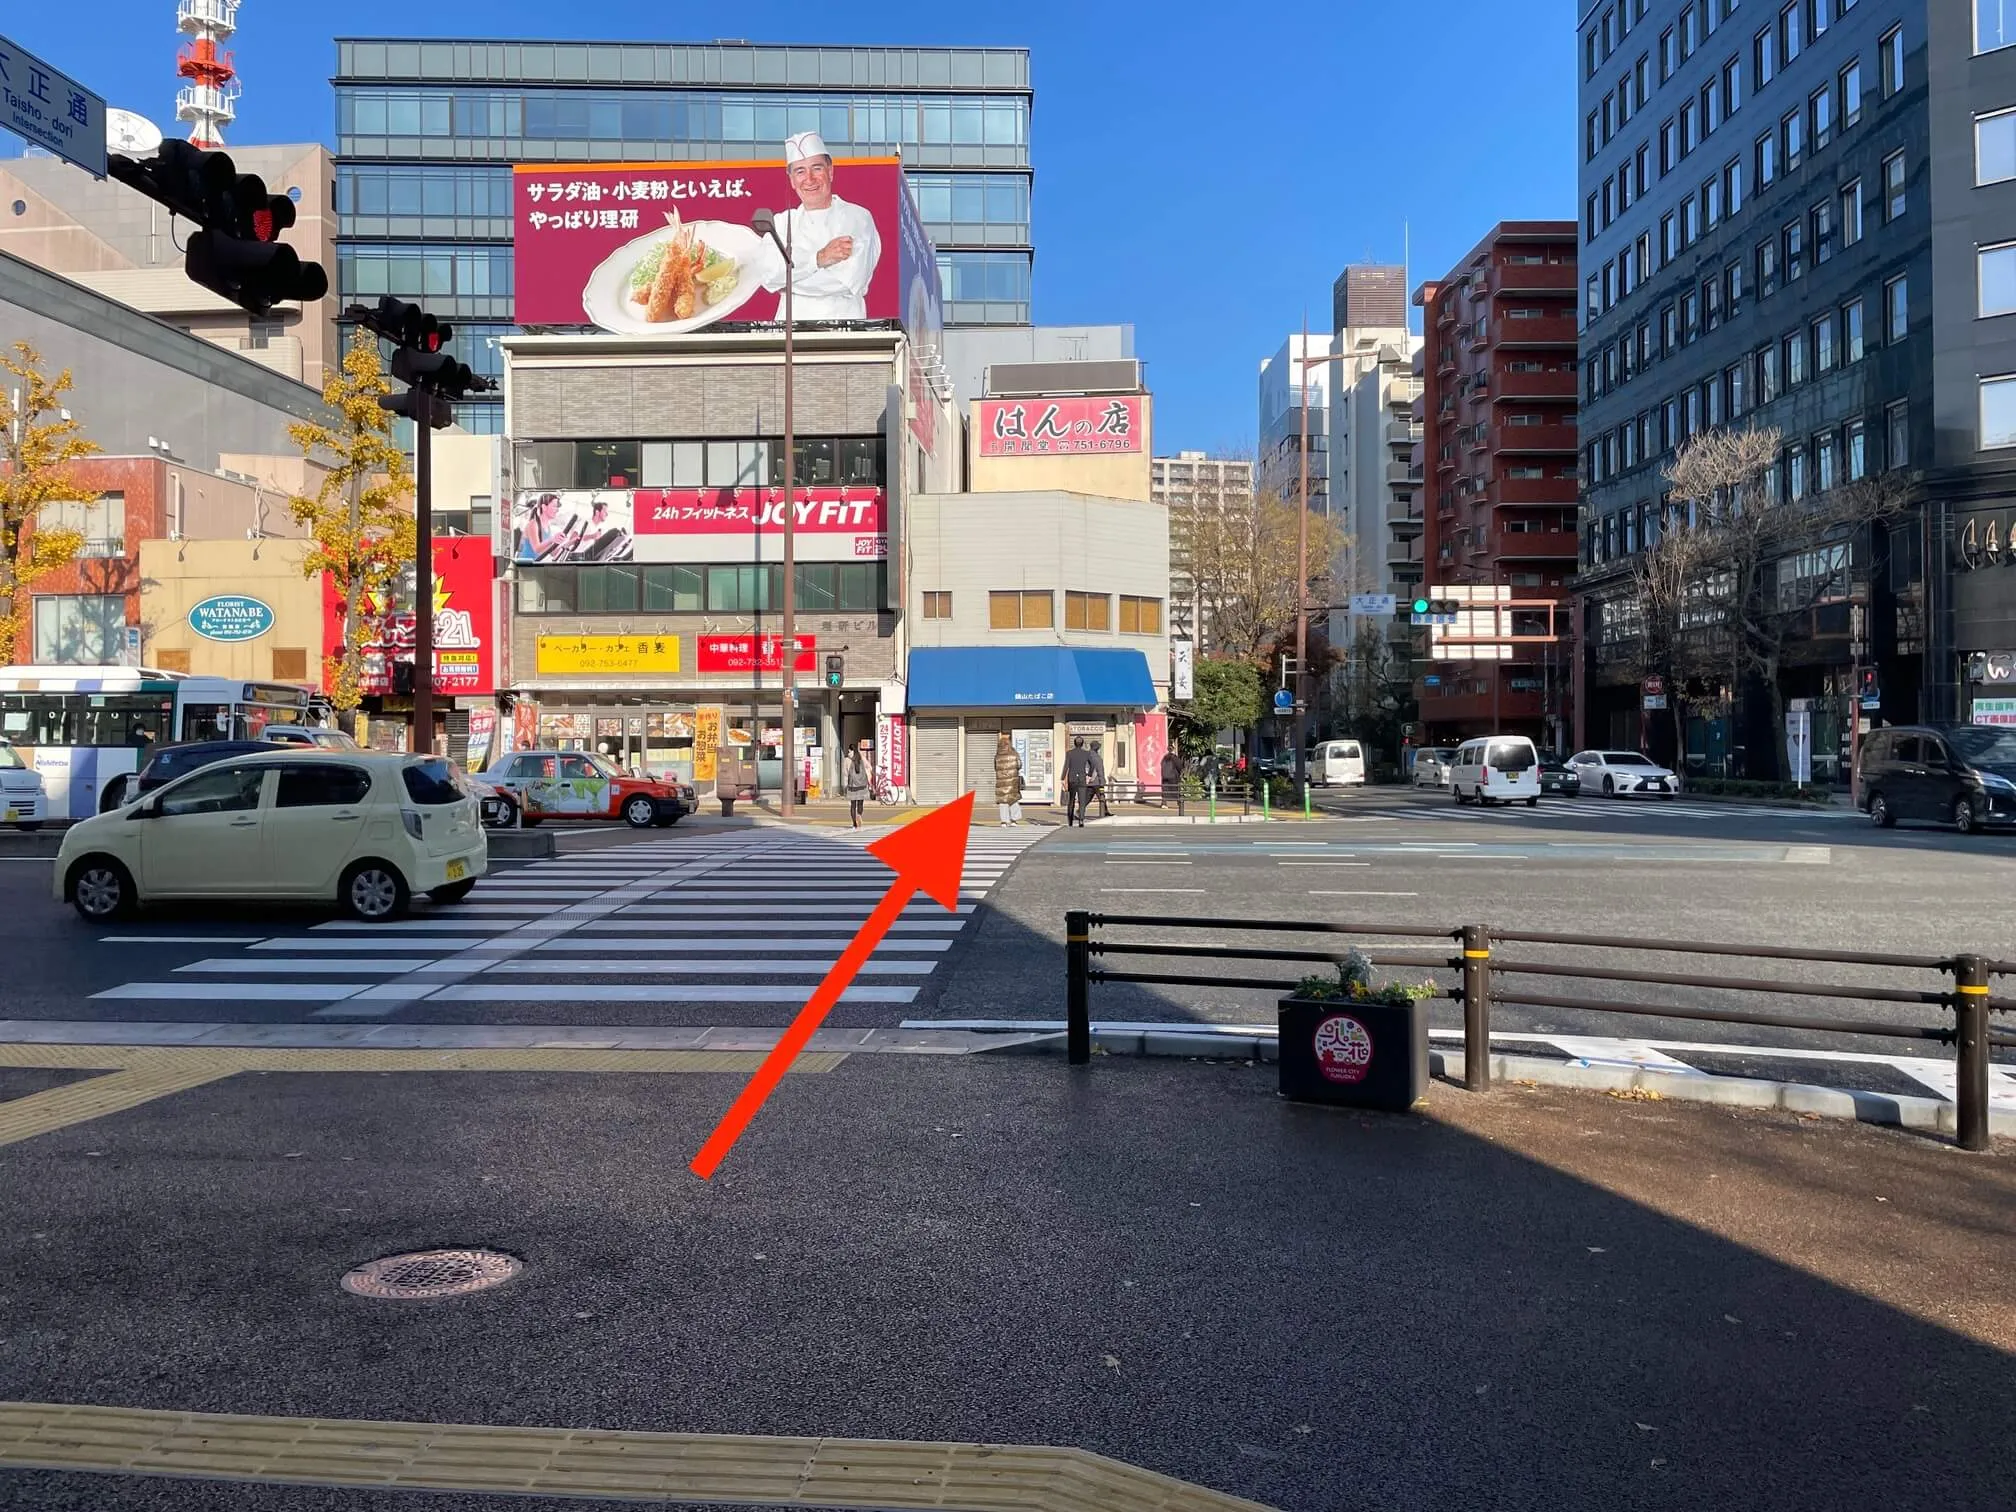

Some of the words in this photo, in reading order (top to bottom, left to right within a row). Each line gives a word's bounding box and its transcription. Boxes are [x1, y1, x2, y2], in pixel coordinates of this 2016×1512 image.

[12, 111, 63, 148] Intersection
[529, 208, 639, 230] やっぱり理研
[994, 401, 1130, 438] はんの店
[1074, 439, 1130, 449] 751-6796
[652, 507, 679, 520] 24h
[682, 507, 749, 520] フィットネス
[751, 501, 819, 525] JOY
[199, 607, 264, 618] WATANABE
[709, 643, 749, 653] 中華料理
[431, 677, 478, 687] 07-2177
[706, 722, 718, 753] お弁当
